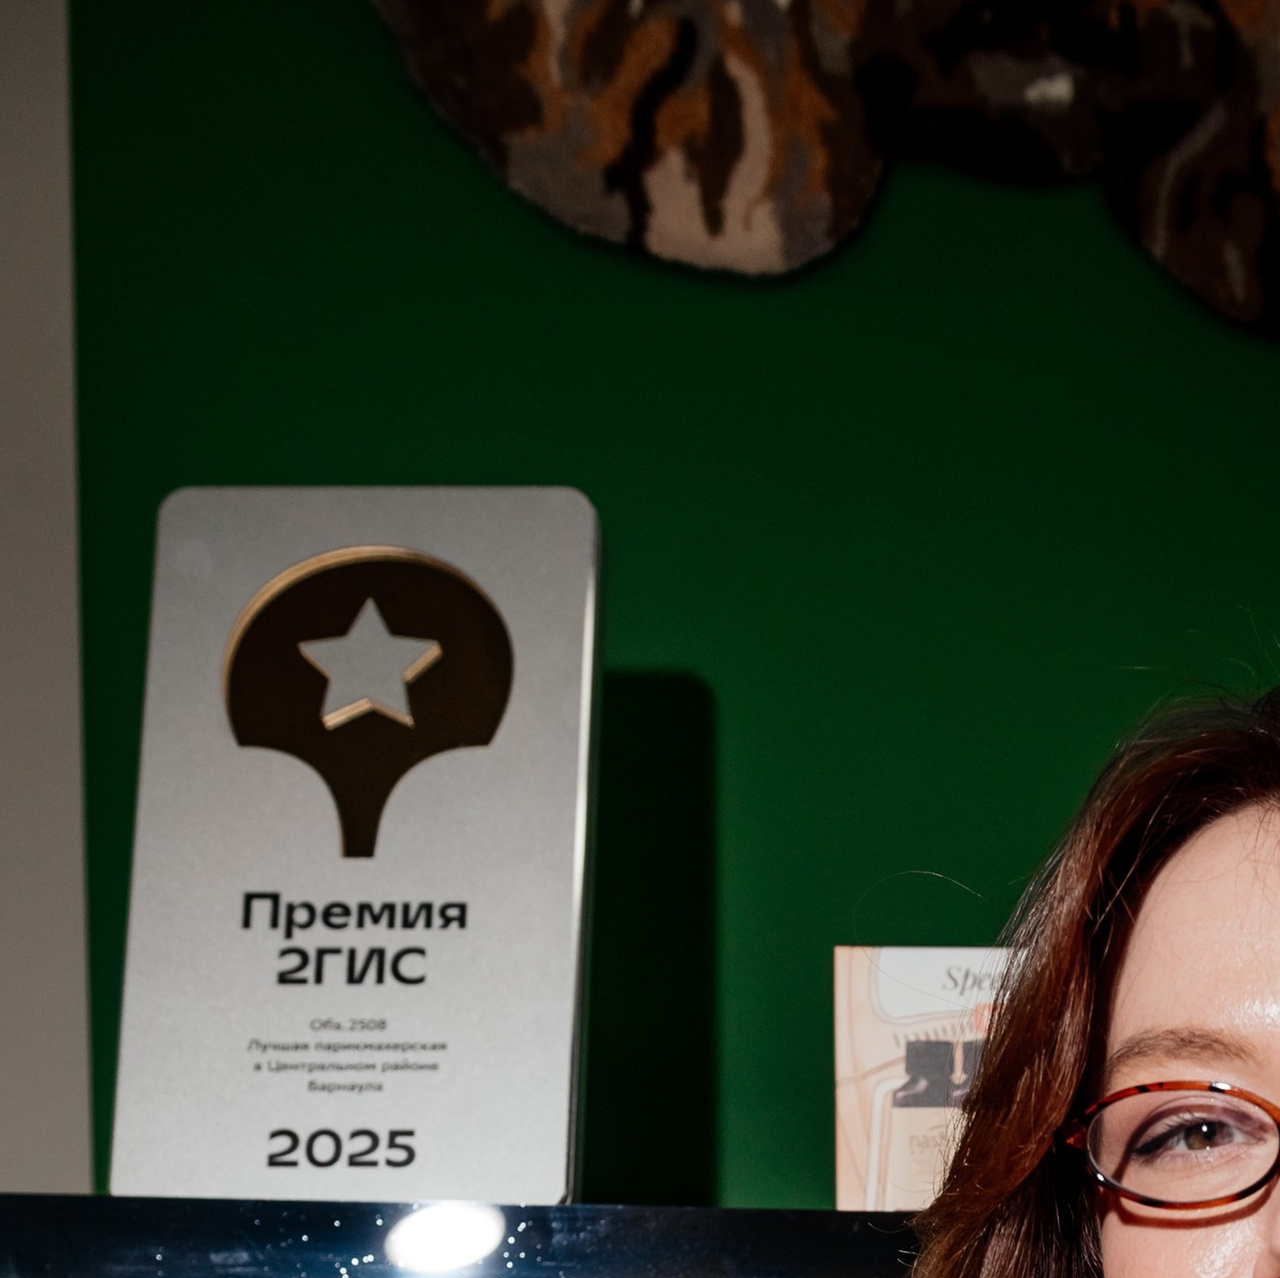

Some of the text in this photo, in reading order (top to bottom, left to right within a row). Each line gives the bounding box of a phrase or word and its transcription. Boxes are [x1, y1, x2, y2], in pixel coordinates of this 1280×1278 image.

[241, 891, 468, 939] Премия
[276, 946, 427, 985] 2ГИС
[247, 1038, 448, 1054] Лучшая парикмахерская
[267, 1059, 376, 1073] Центральном
[381, 1057, 440, 1073] районе
[307, 1079, 384, 1093] Барнаула
[266, 1128, 416, 1168] 2025
